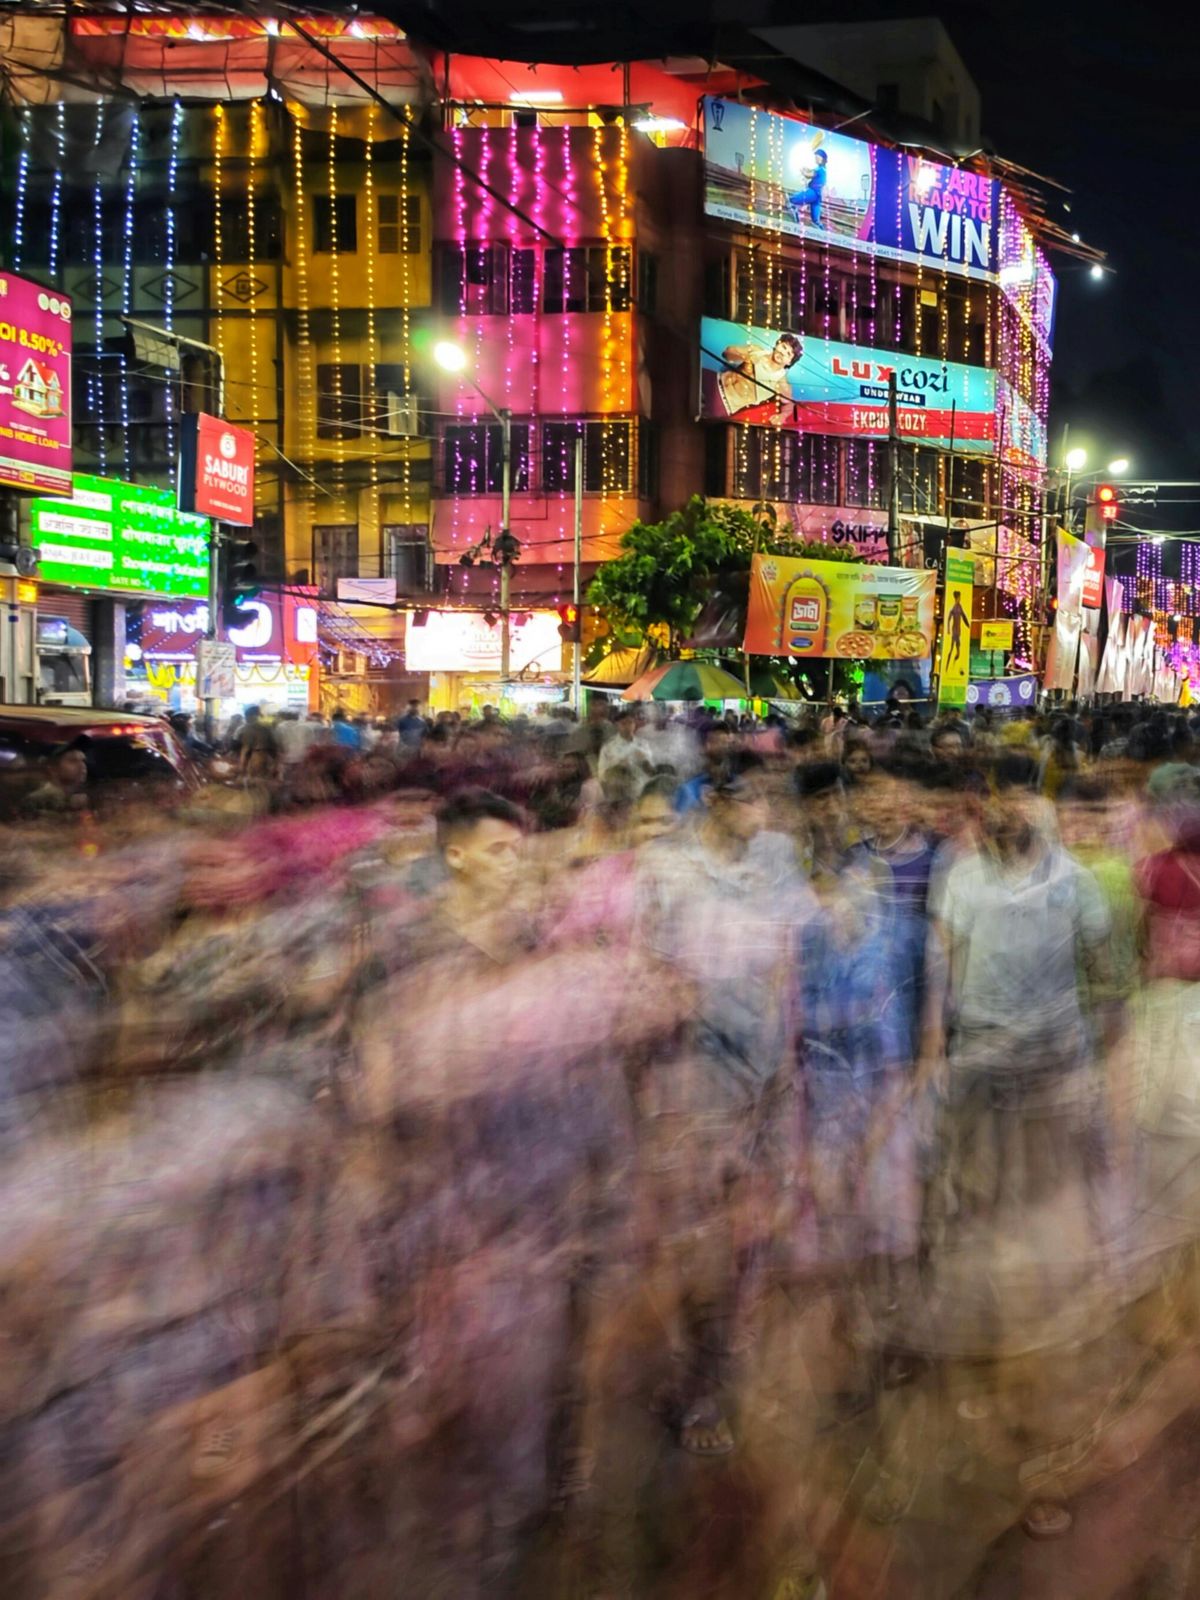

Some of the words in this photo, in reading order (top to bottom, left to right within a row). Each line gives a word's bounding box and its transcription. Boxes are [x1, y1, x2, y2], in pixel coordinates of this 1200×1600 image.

[948, 168, 991, 202] ARE
[908, 184, 966, 214] READY
[969, 200, 991, 223] TO
[908, 203, 990, 267] WIN
[833, 358, 893, 382] LUX
[901, 366, 949, 393] cozi
[863, 387, 921, 404] UNDEWEAR
[898, 413, 927, 430] COZY
[203, 474, 248, 497] PLYWOOD
[204, 454, 251, 486] SABURI
[831, 519, 889, 543] SKIPP
